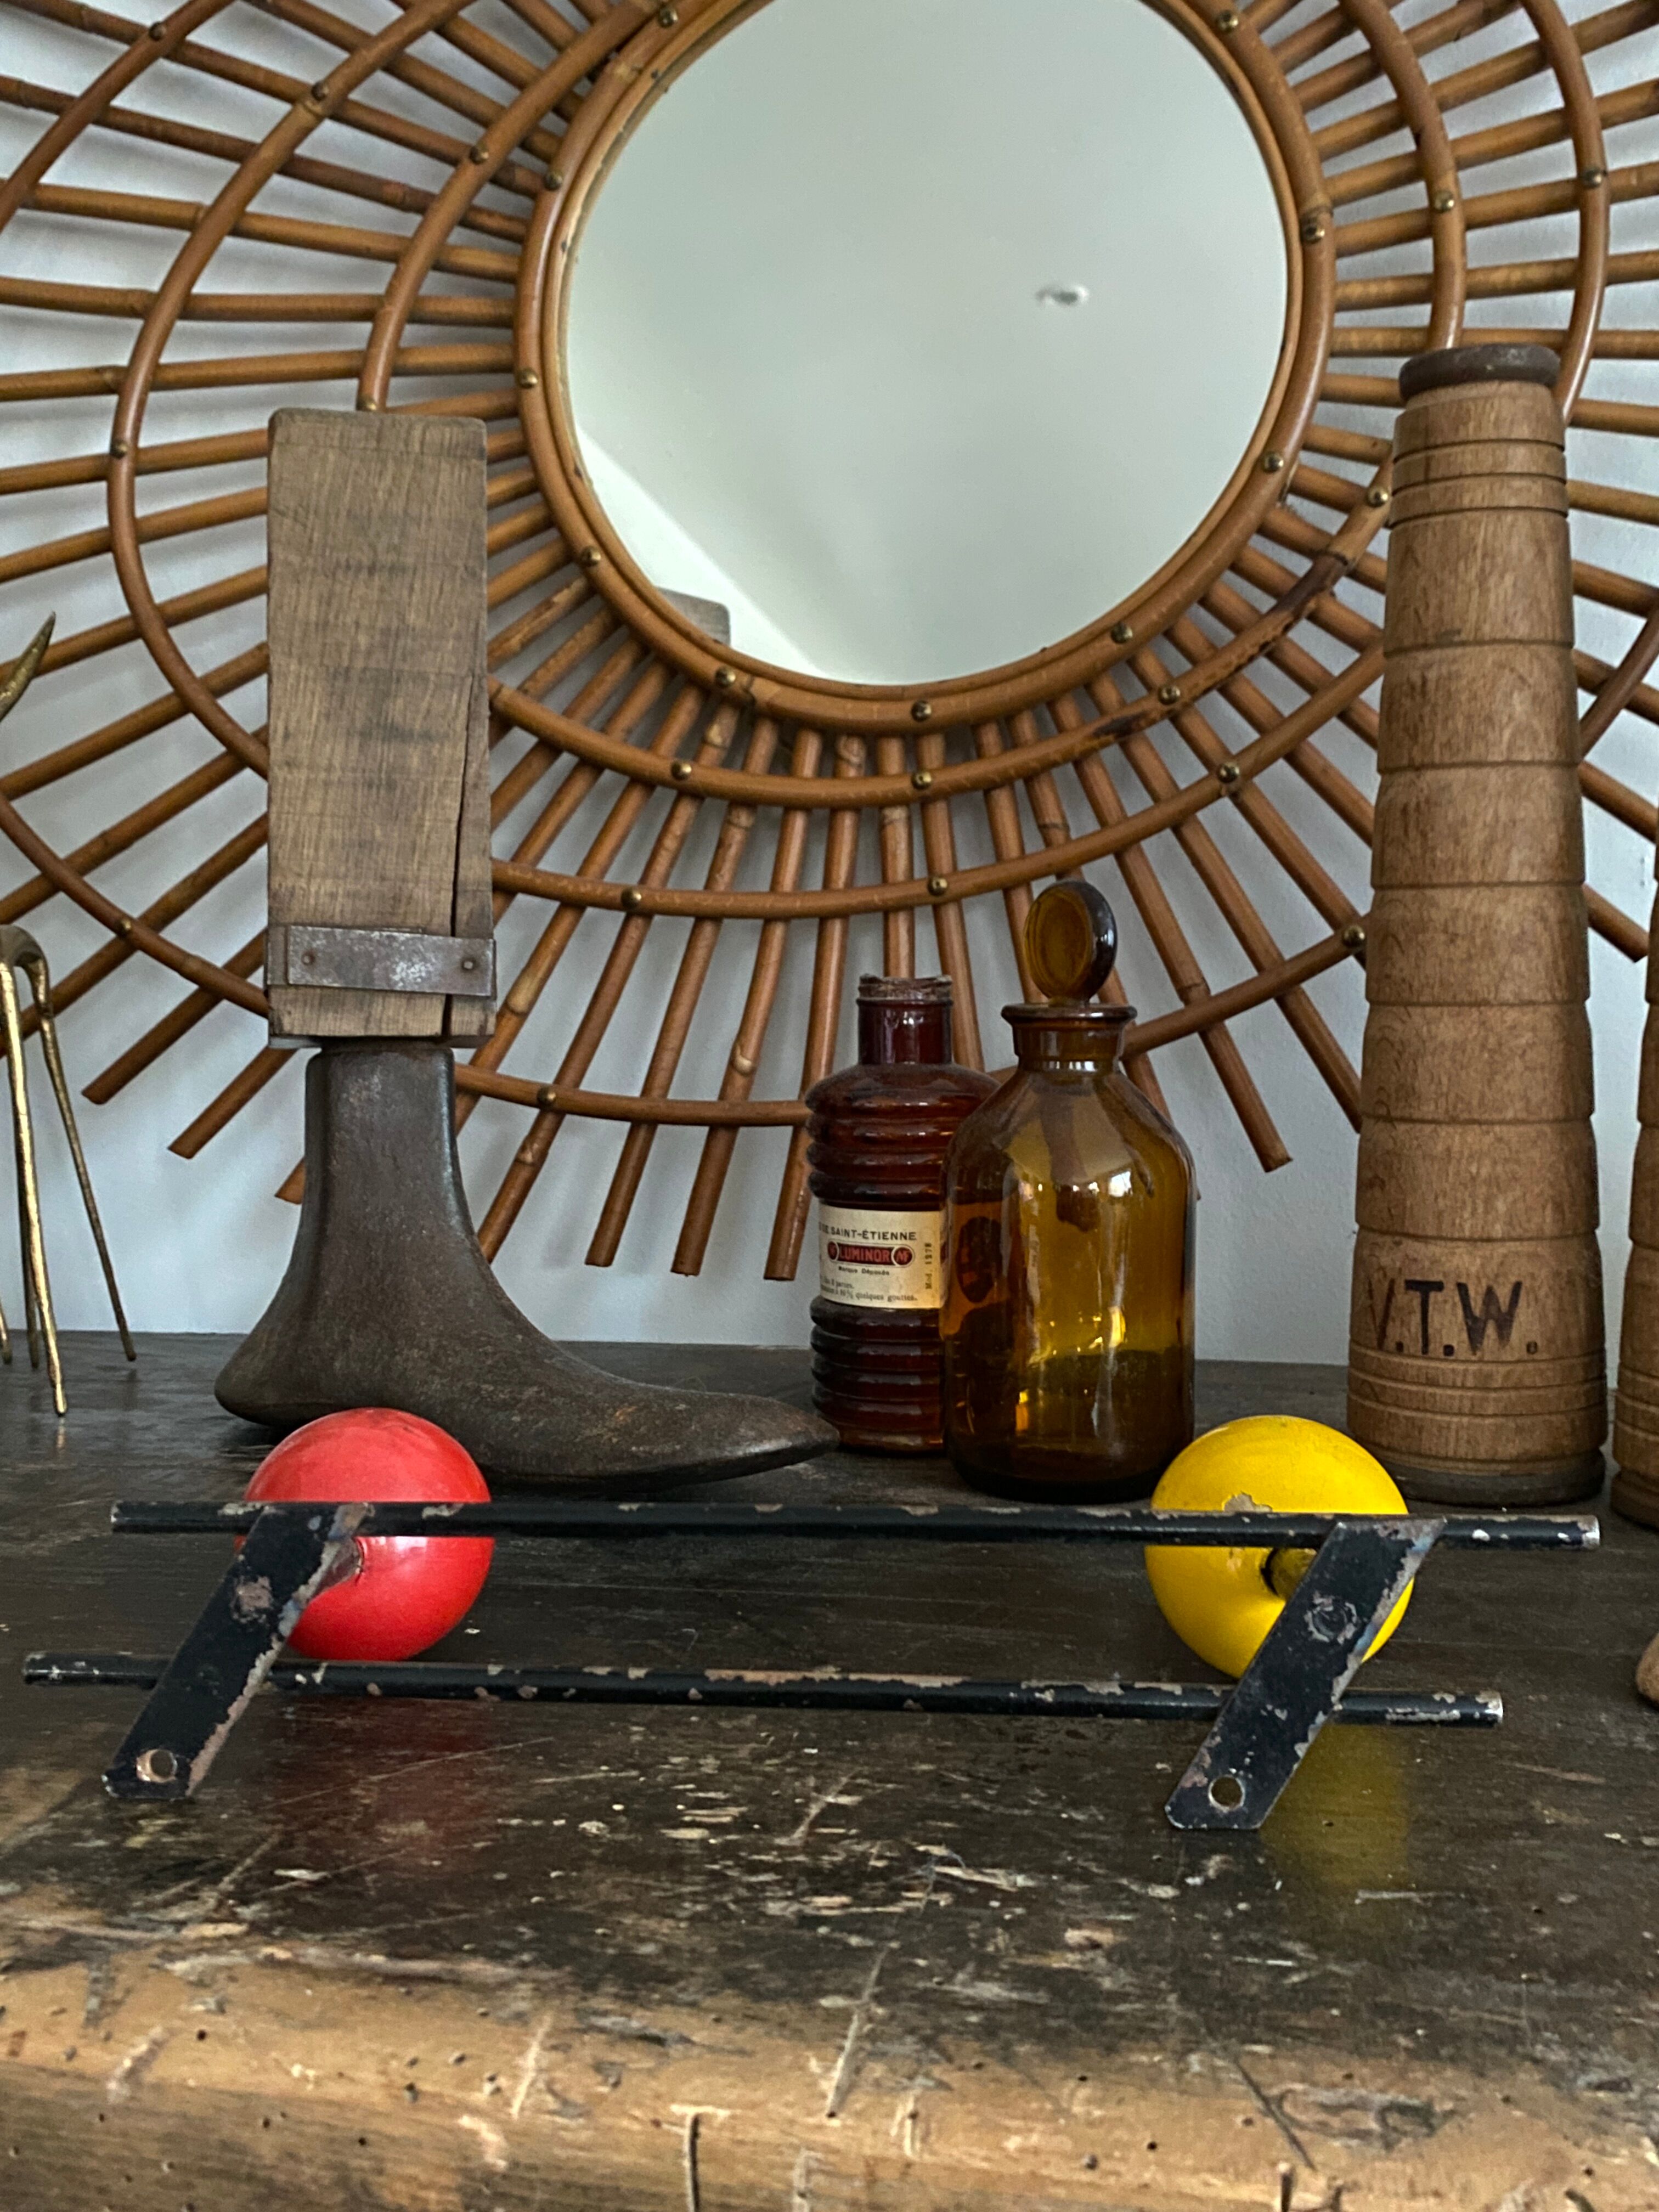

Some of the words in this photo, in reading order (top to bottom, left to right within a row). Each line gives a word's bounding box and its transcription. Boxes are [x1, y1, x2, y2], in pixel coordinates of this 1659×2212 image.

[831, 1226, 917, 1240] SAINT-ÉTIENNE
[840, 1245, 890, 1262] LUMINOR
[838, 1266, 857, 1274] Marque
[861, 1267, 890, 1276] Déposée
[856, 1291, 884, 1302] quelques
[887, 1294, 918, 1302] gouttes.
[1368, 1277, 1538, 1357] V.T.W.
